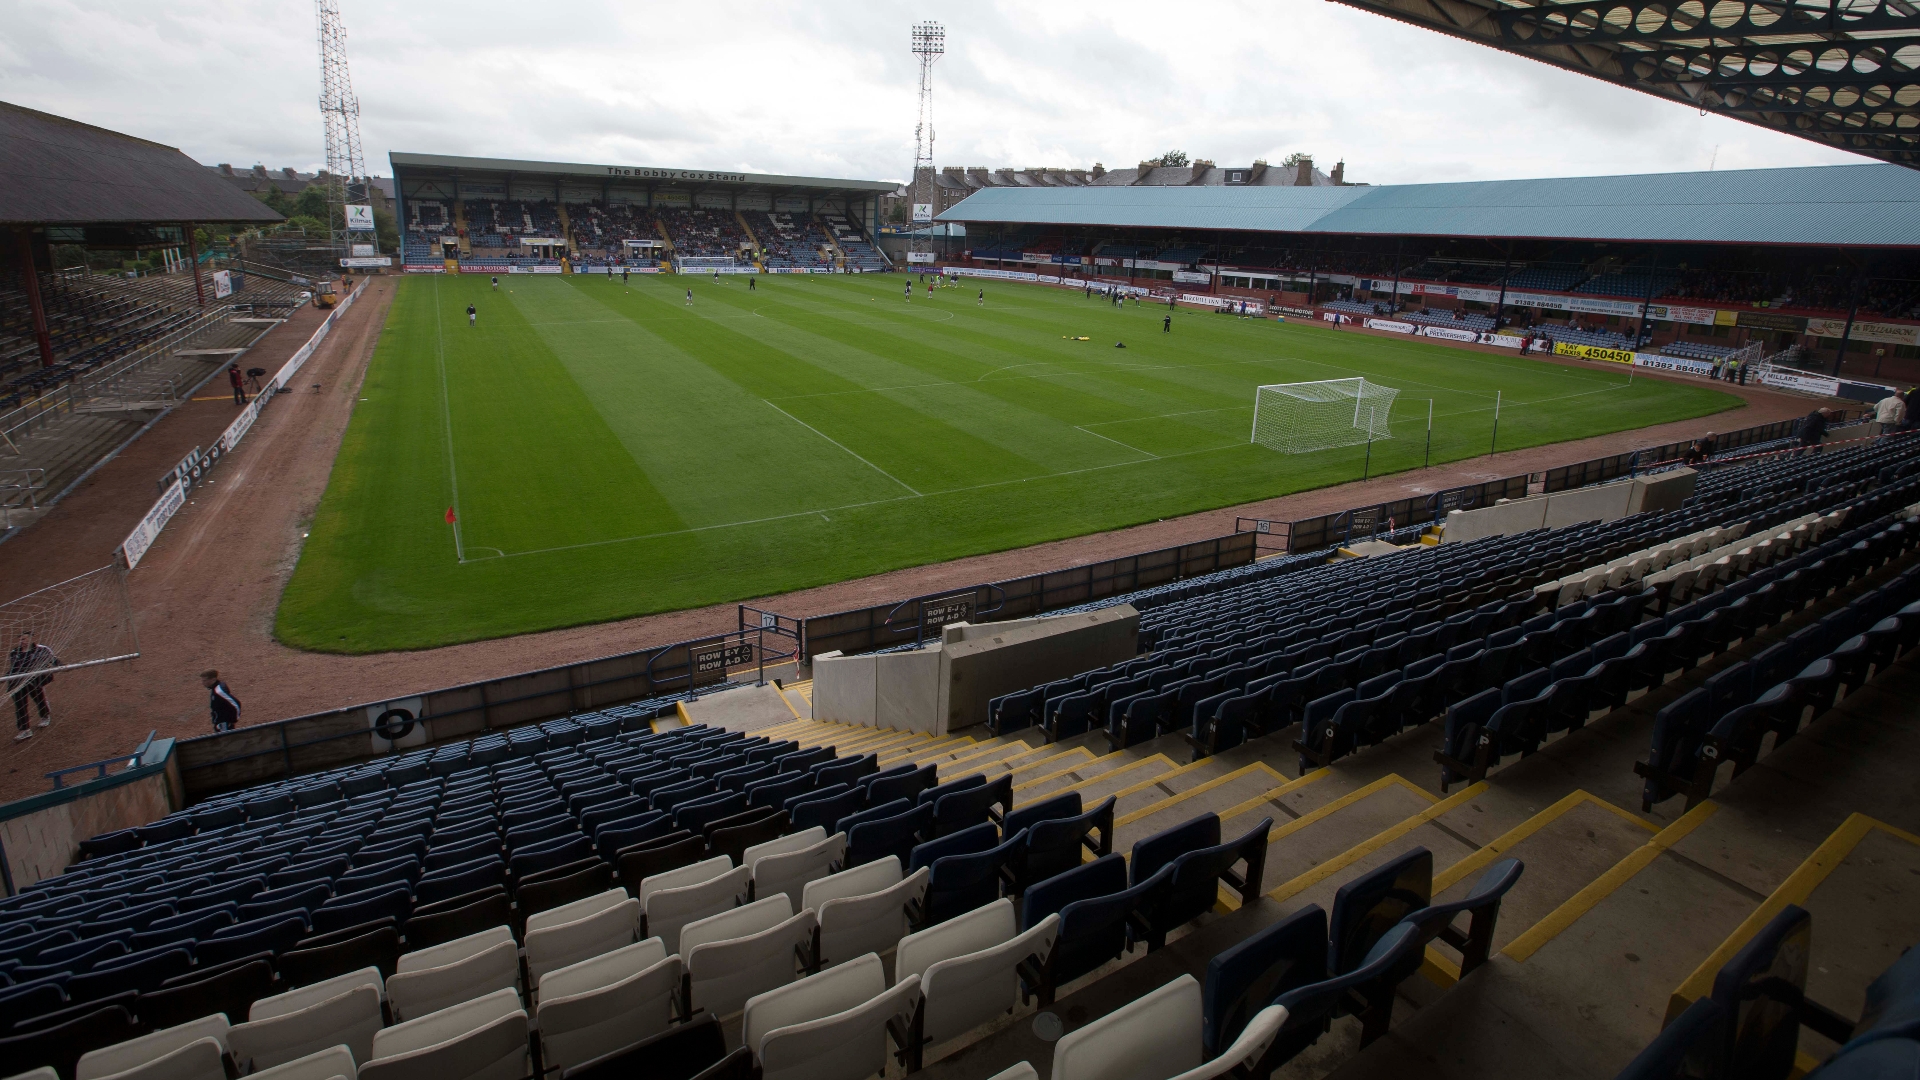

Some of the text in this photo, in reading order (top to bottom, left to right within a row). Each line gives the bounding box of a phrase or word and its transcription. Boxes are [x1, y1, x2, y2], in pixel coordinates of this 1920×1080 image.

[607, 167, 745, 182] The Bobby Cox Stand
[1095, 258, 1111, 266] PUMA
[1613, 302, 1635, 311] LOTTERY
[1324, 313, 1345, 323] PUA
[1863, 325, 1913, 336] WILLIAMSON
[1560, 348, 1631, 363] TAXIS 450450
[1643, 360, 1712, 375] 01382 884450
[1767, 373, 1799, 382] MILLAR'S
[1258, 523, 1268, 531] 16
[927, 605, 959, 617] ROW E-J
[763, 615, 774, 627] 17
[927, 613, 959, 625] ROW A-D
[698, 648, 739, 662] ROW E-Y
[698, 656, 741, 671] ROW A-D
[1325, 728, 1334, 737] O
[1479, 735, 1490, 745] P
[1703, 745, 1718, 759] Q
